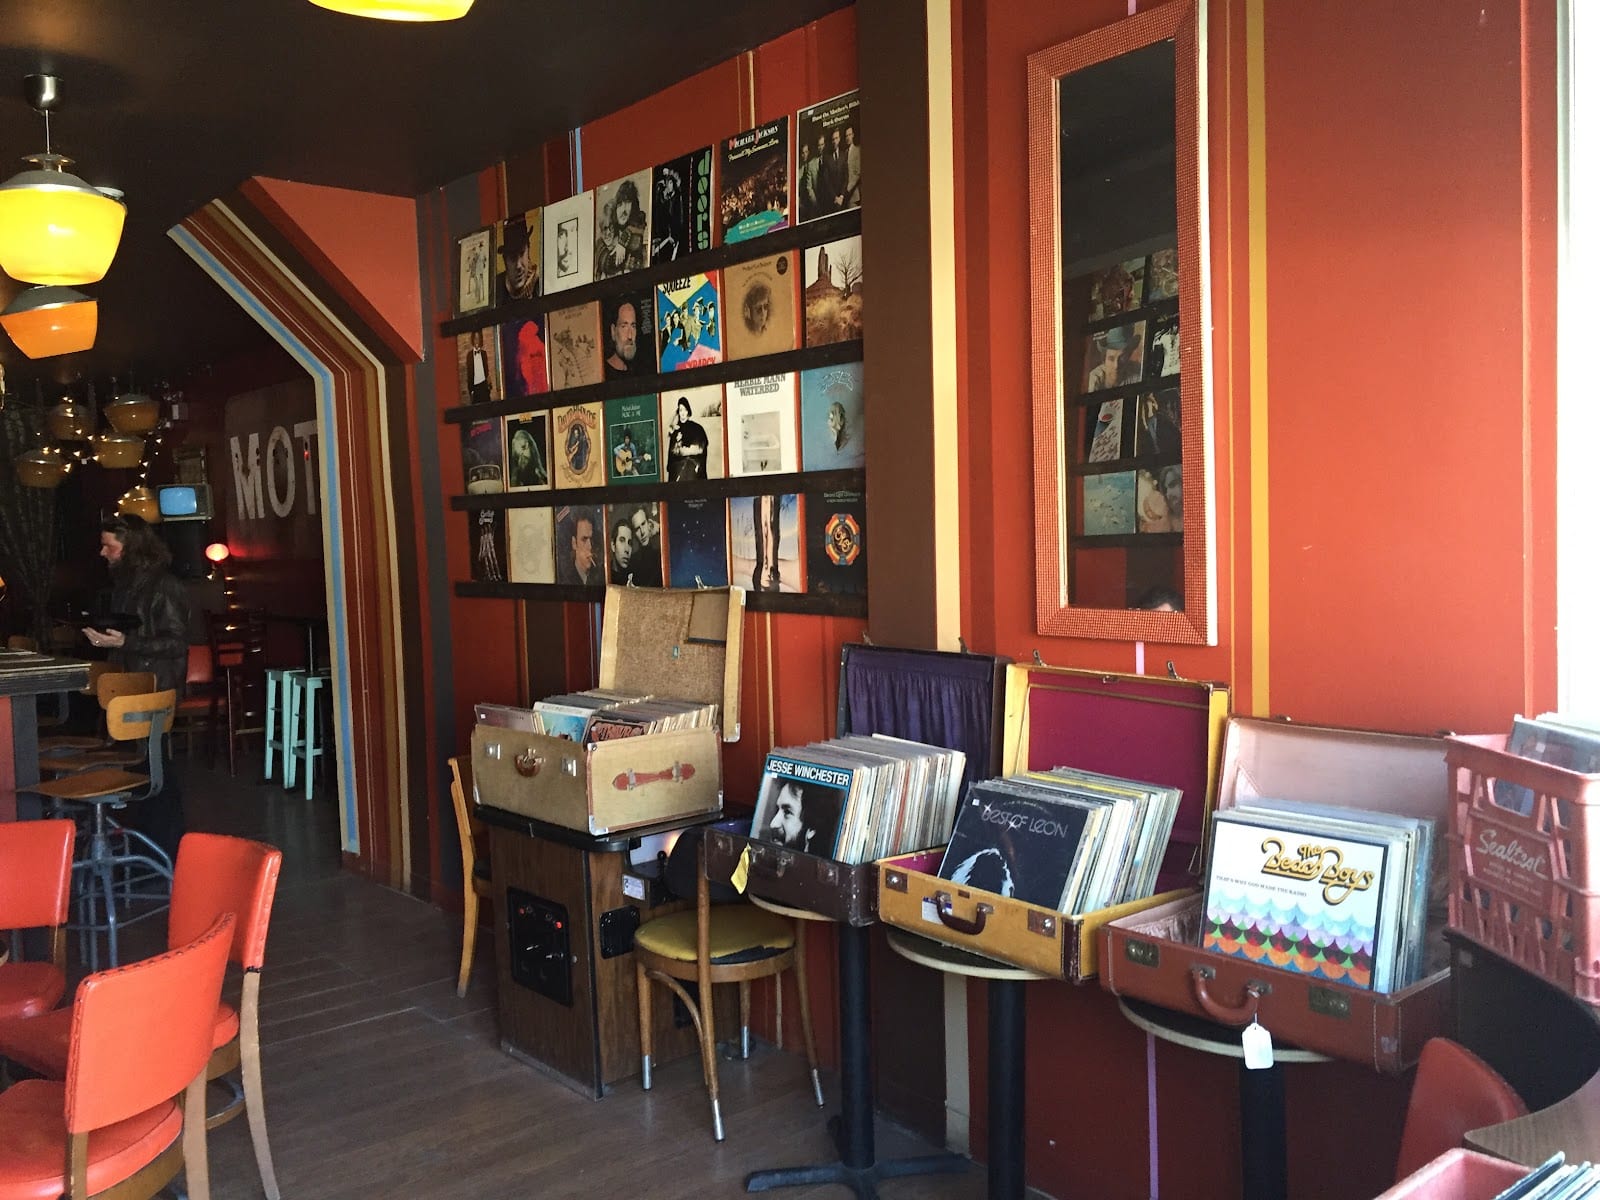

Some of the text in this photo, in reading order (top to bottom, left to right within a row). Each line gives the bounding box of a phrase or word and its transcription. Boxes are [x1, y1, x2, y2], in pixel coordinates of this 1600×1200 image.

[663, 277, 690, 296] SQUEEZE
[734, 373, 786, 388] HERBIE MANN
[740, 383, 780, 397] WATERBED
[767, 759, 850, 787] JESSE WINCHESTER
[1476, 829, 1548, 880] Sealtest
[1261, 837, 1375, 906] Beach Boys
